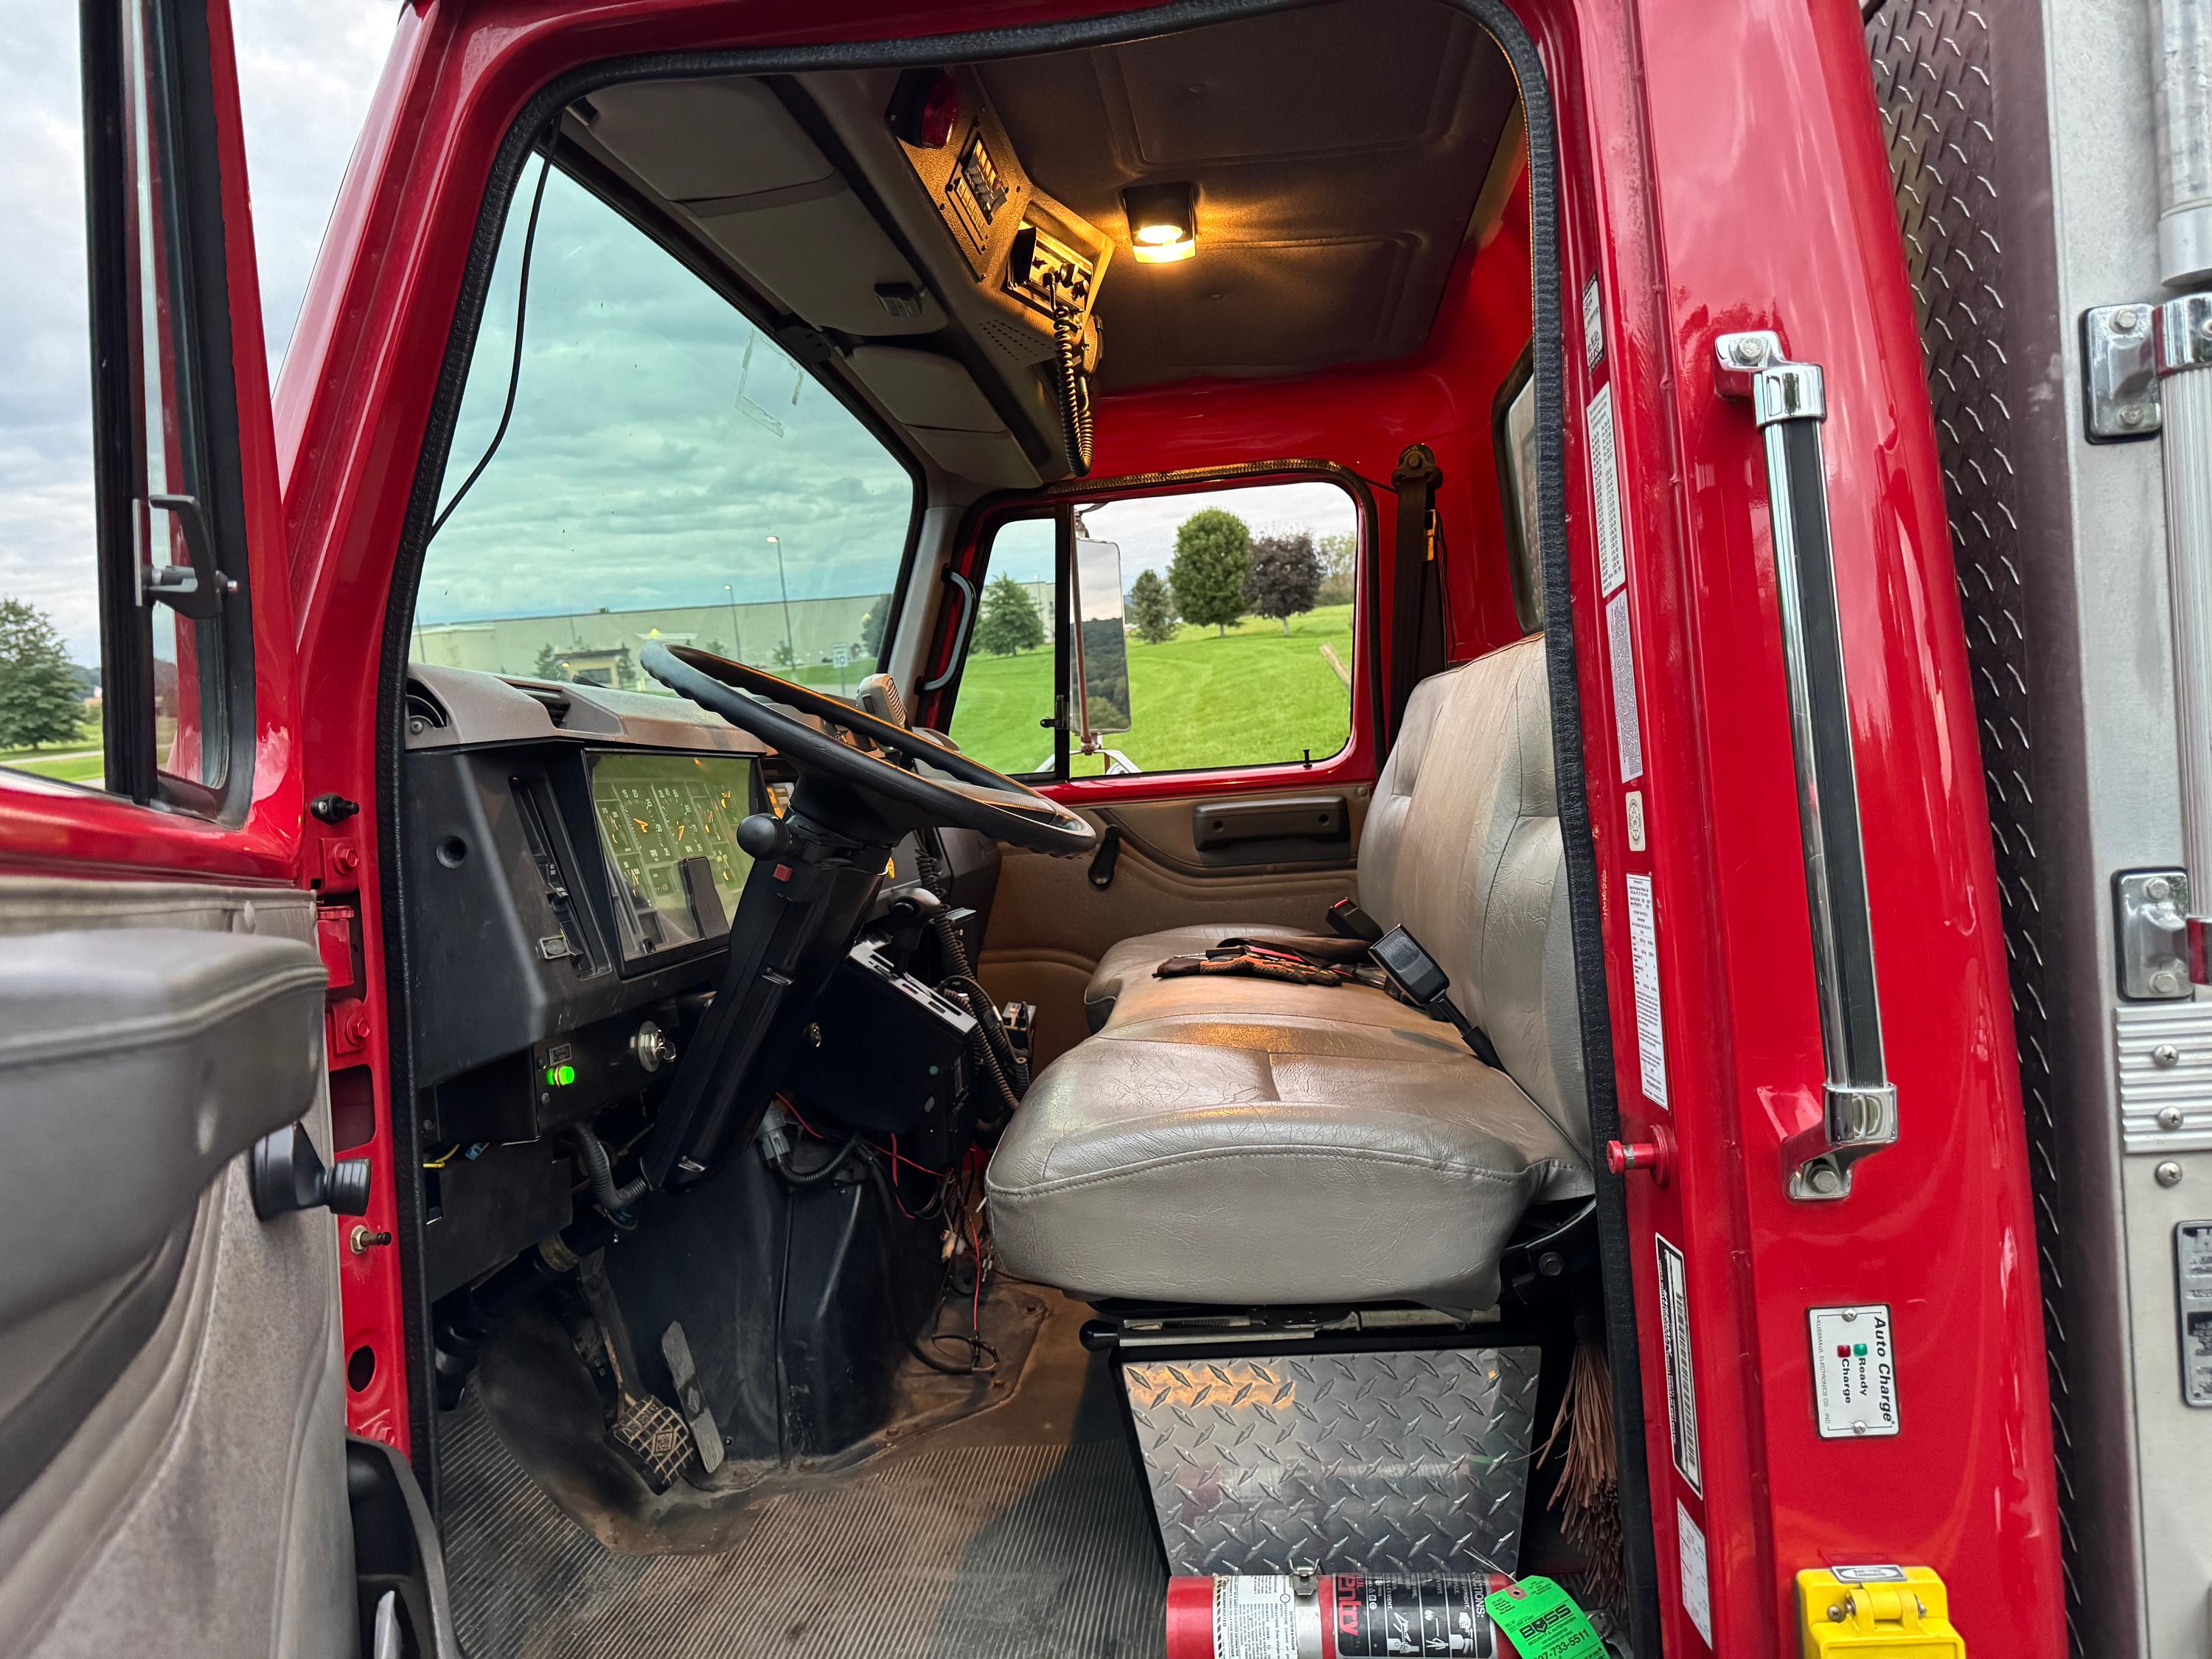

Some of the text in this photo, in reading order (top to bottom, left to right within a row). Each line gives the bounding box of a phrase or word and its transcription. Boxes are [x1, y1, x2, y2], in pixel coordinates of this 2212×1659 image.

[1874, 1317, 1886, 1357] Auto
[1842, 1358, 1851, 1404] Charge
[1858, 1357, 1867, 1396] Ready
